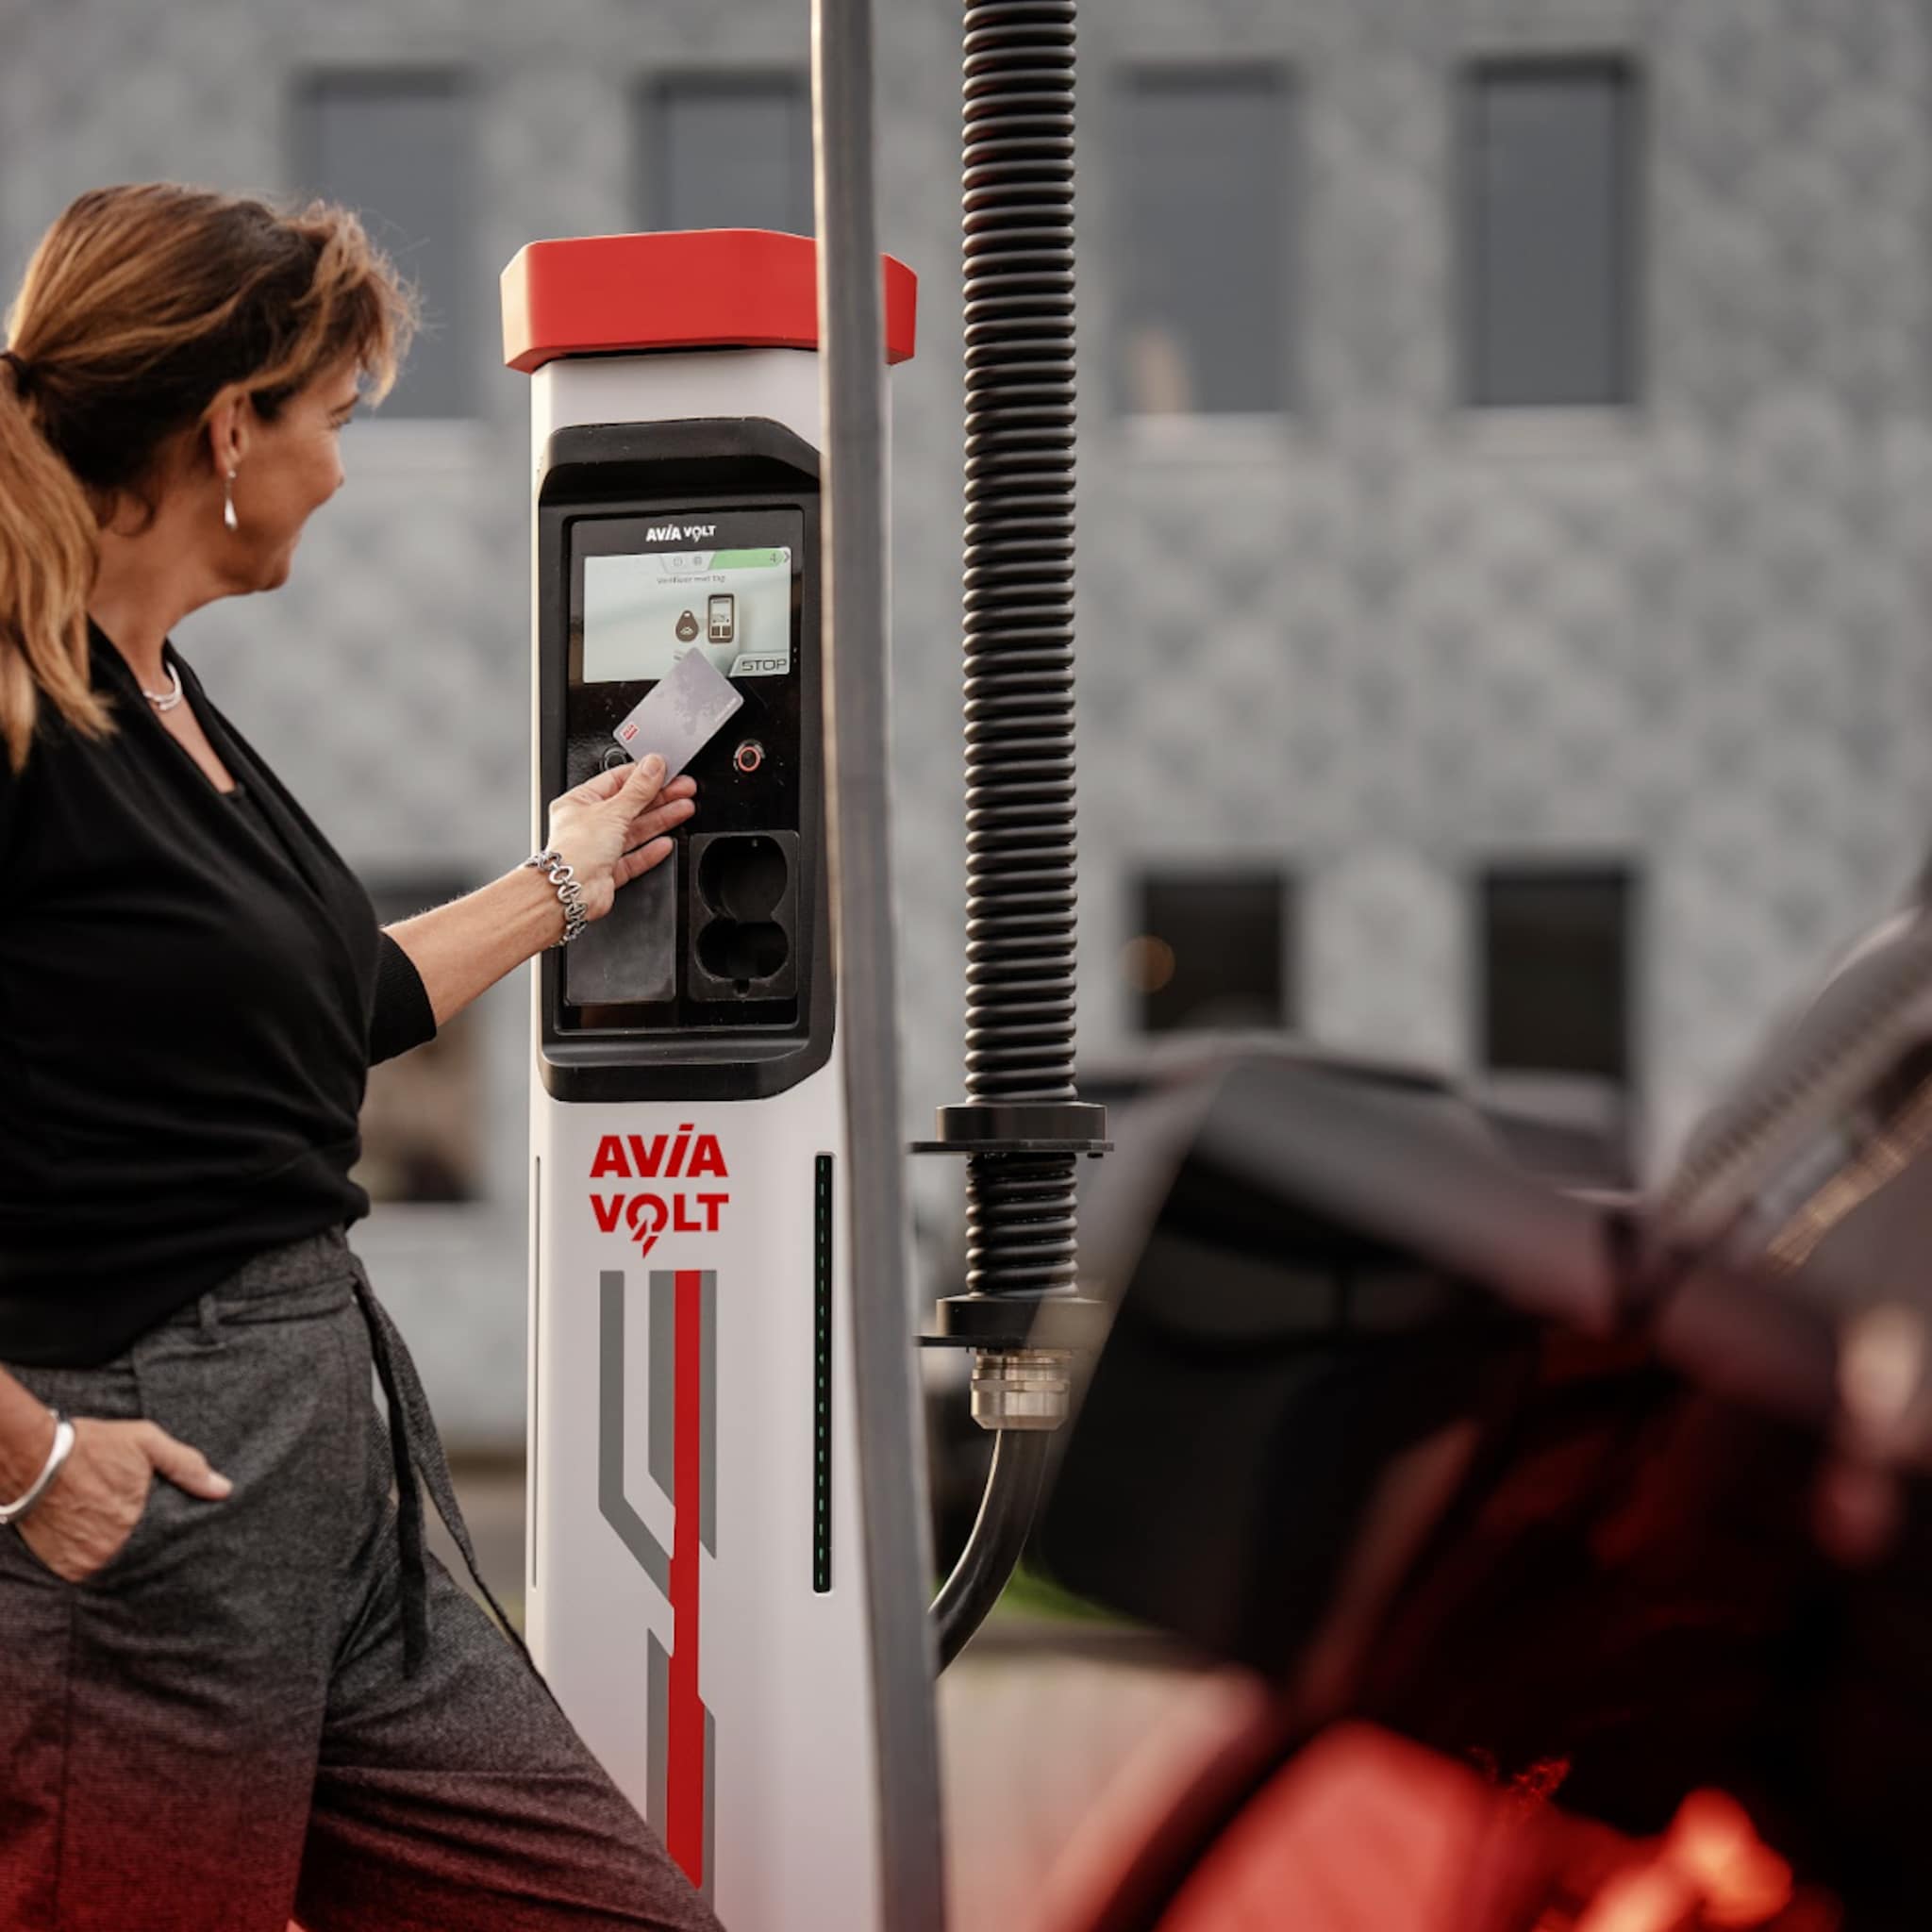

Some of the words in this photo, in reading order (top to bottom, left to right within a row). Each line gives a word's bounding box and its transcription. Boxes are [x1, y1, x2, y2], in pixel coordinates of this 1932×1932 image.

[683, 525, 717, 542] VOLT
[741, 658, 788, 672] STOP
[590, 1192, 730, 1259] VOLT
